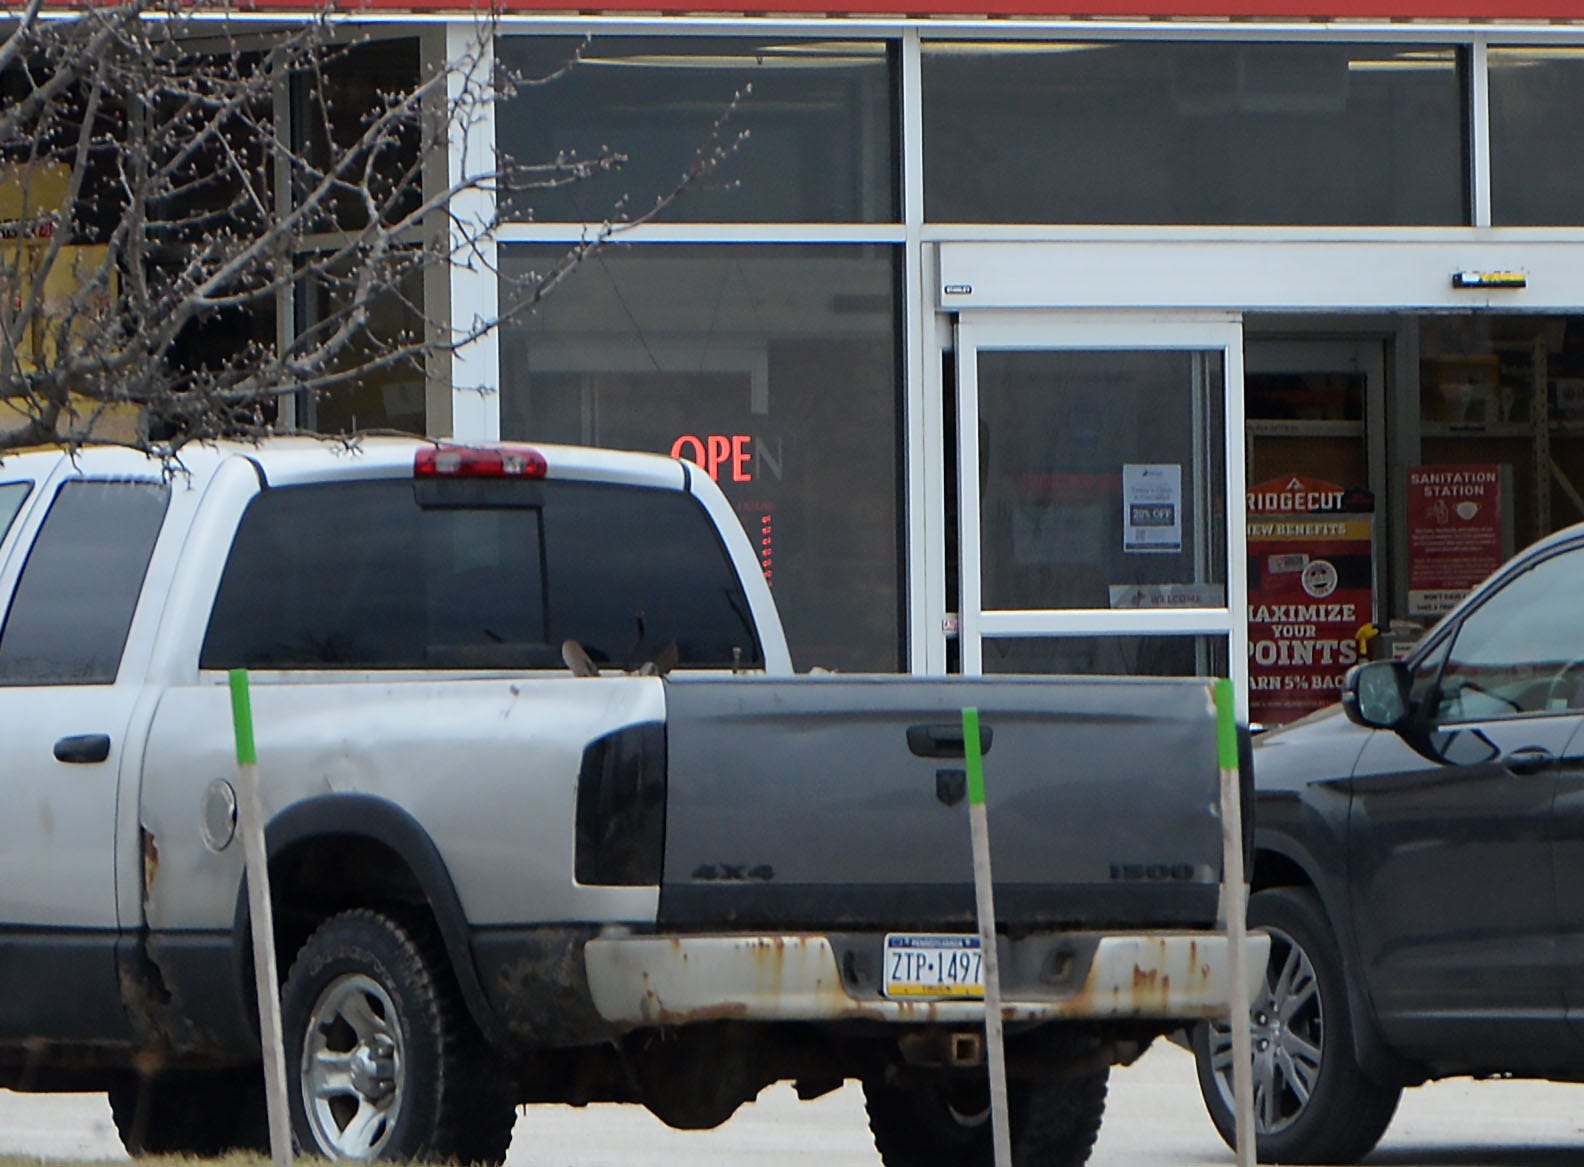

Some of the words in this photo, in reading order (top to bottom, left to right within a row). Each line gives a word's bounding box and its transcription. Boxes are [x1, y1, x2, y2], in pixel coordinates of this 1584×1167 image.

[670, 435, 784, 482] OPEN
[1411, 471, 1496, 485] SANITATION
[1424, 485, 1484, 497] STATION
[1247, 492, 1345, 511] RIDGECUT
[1277, 522, 1346, 536] BENEFITS
[1272, 624, 1316, 637] YOUR
[1249, 675, 1282, 690] ARN
[1285, 675, 1309, 689] 5%
